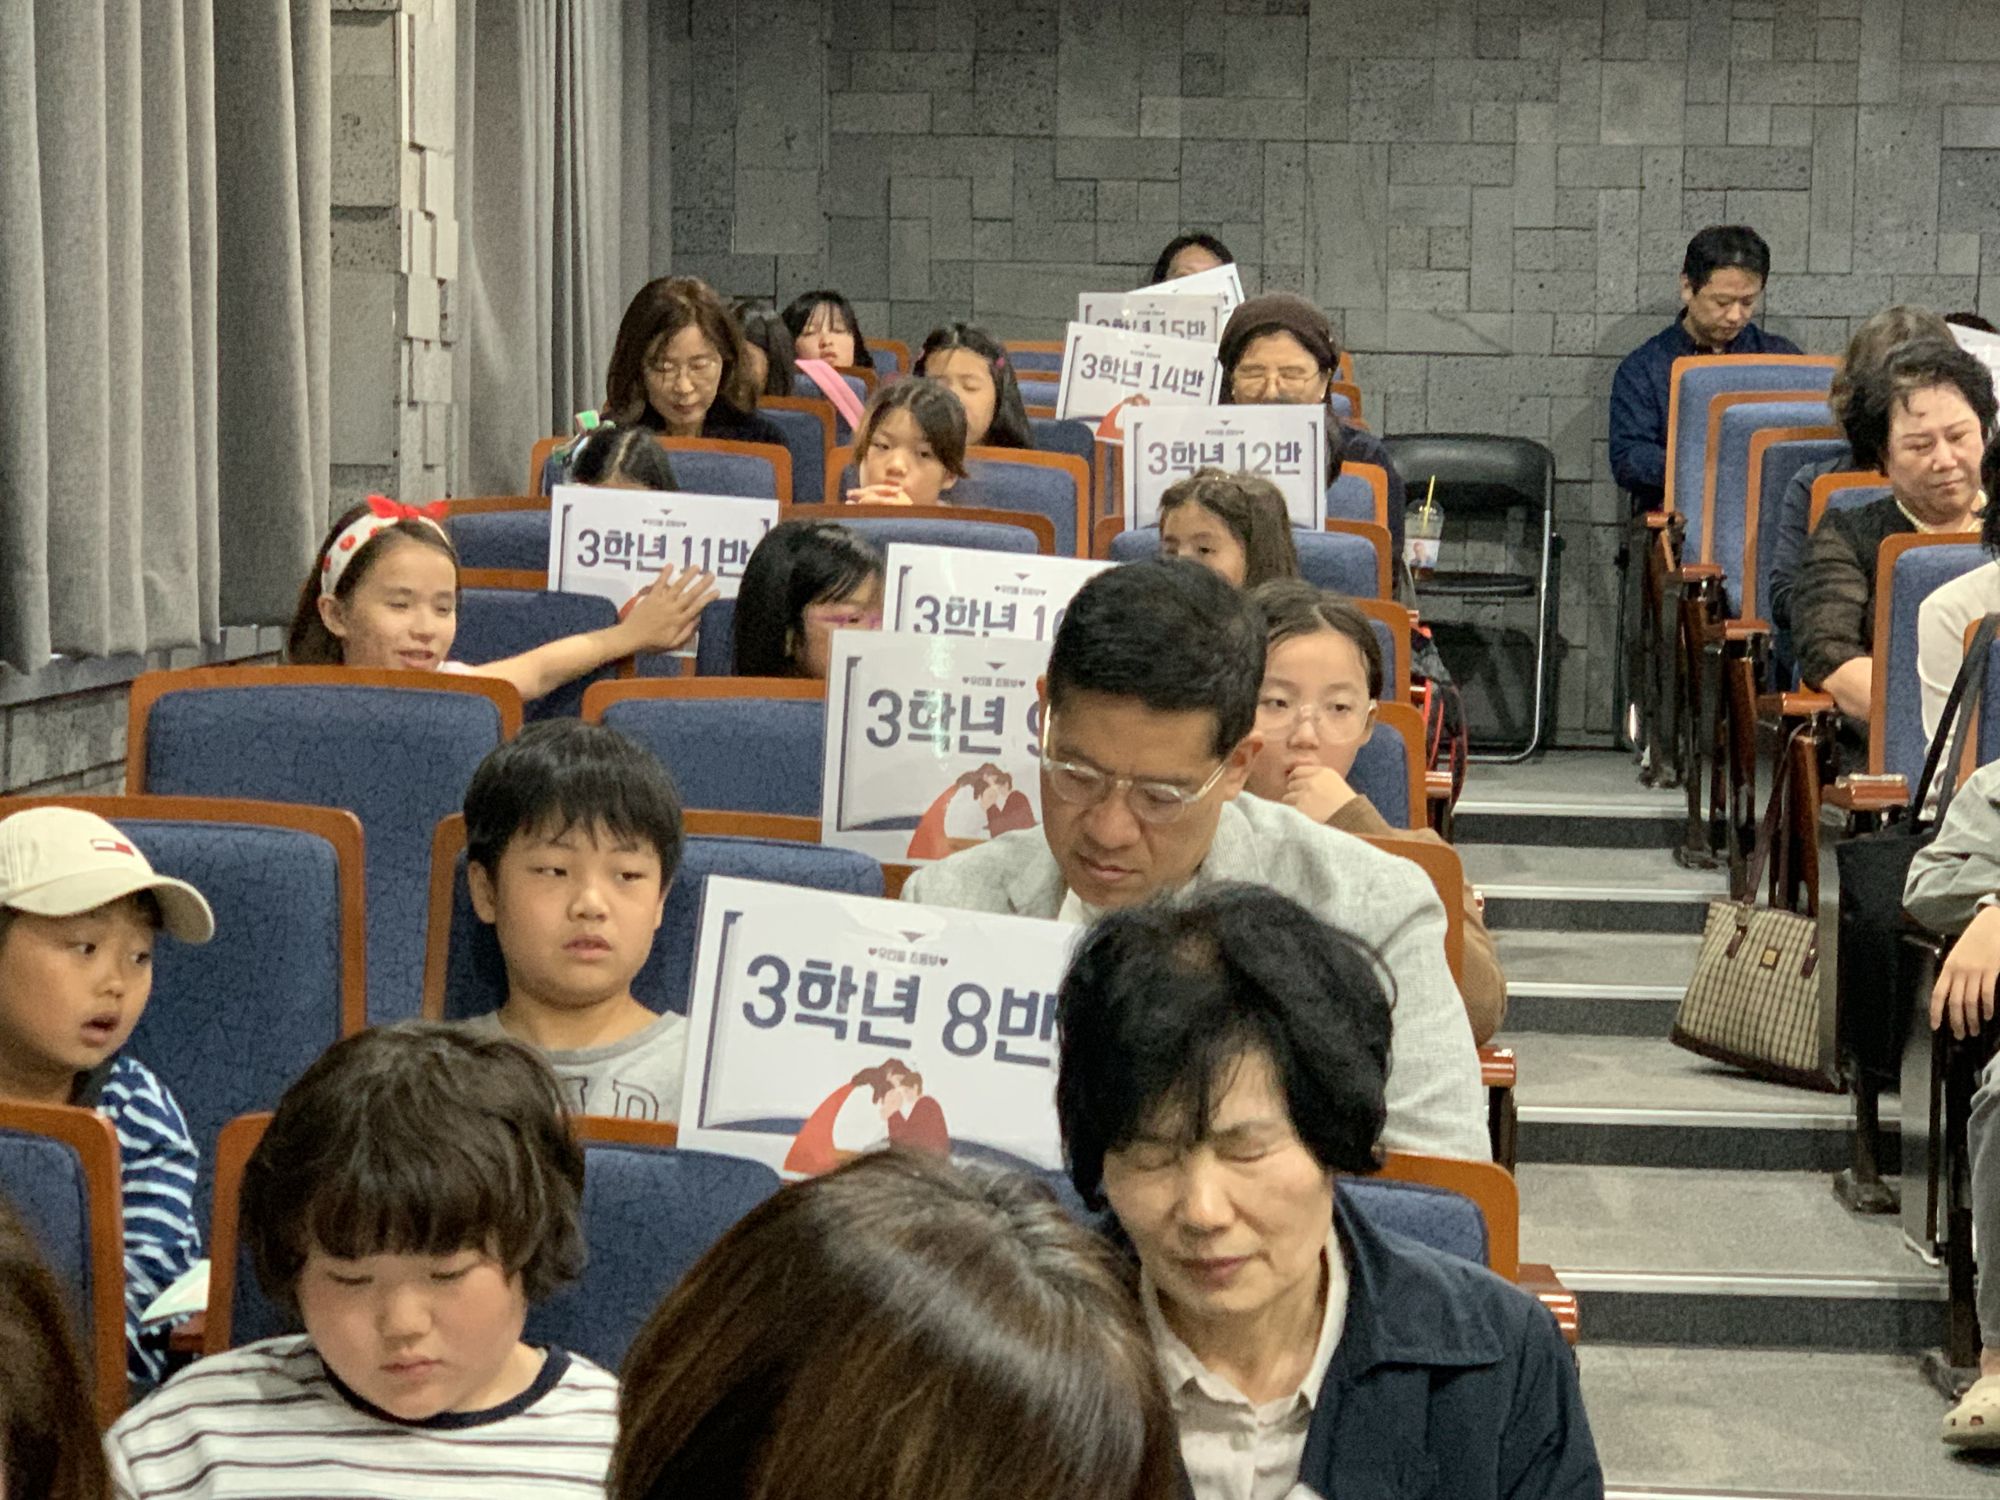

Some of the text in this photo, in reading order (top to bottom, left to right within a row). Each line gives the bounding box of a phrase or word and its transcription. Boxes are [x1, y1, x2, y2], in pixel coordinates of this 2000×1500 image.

[1080, 353, 1204, 396] 3학년 14반
[1236, 441, 1302, 475] 12반
[577, 529, 750, 577] 3학년 11반
[913, 595, 1017, 637] 3학년
[866, 688, 1005, 755] 3학년
[742, 955, 1057, 1067] 3학년 8반
